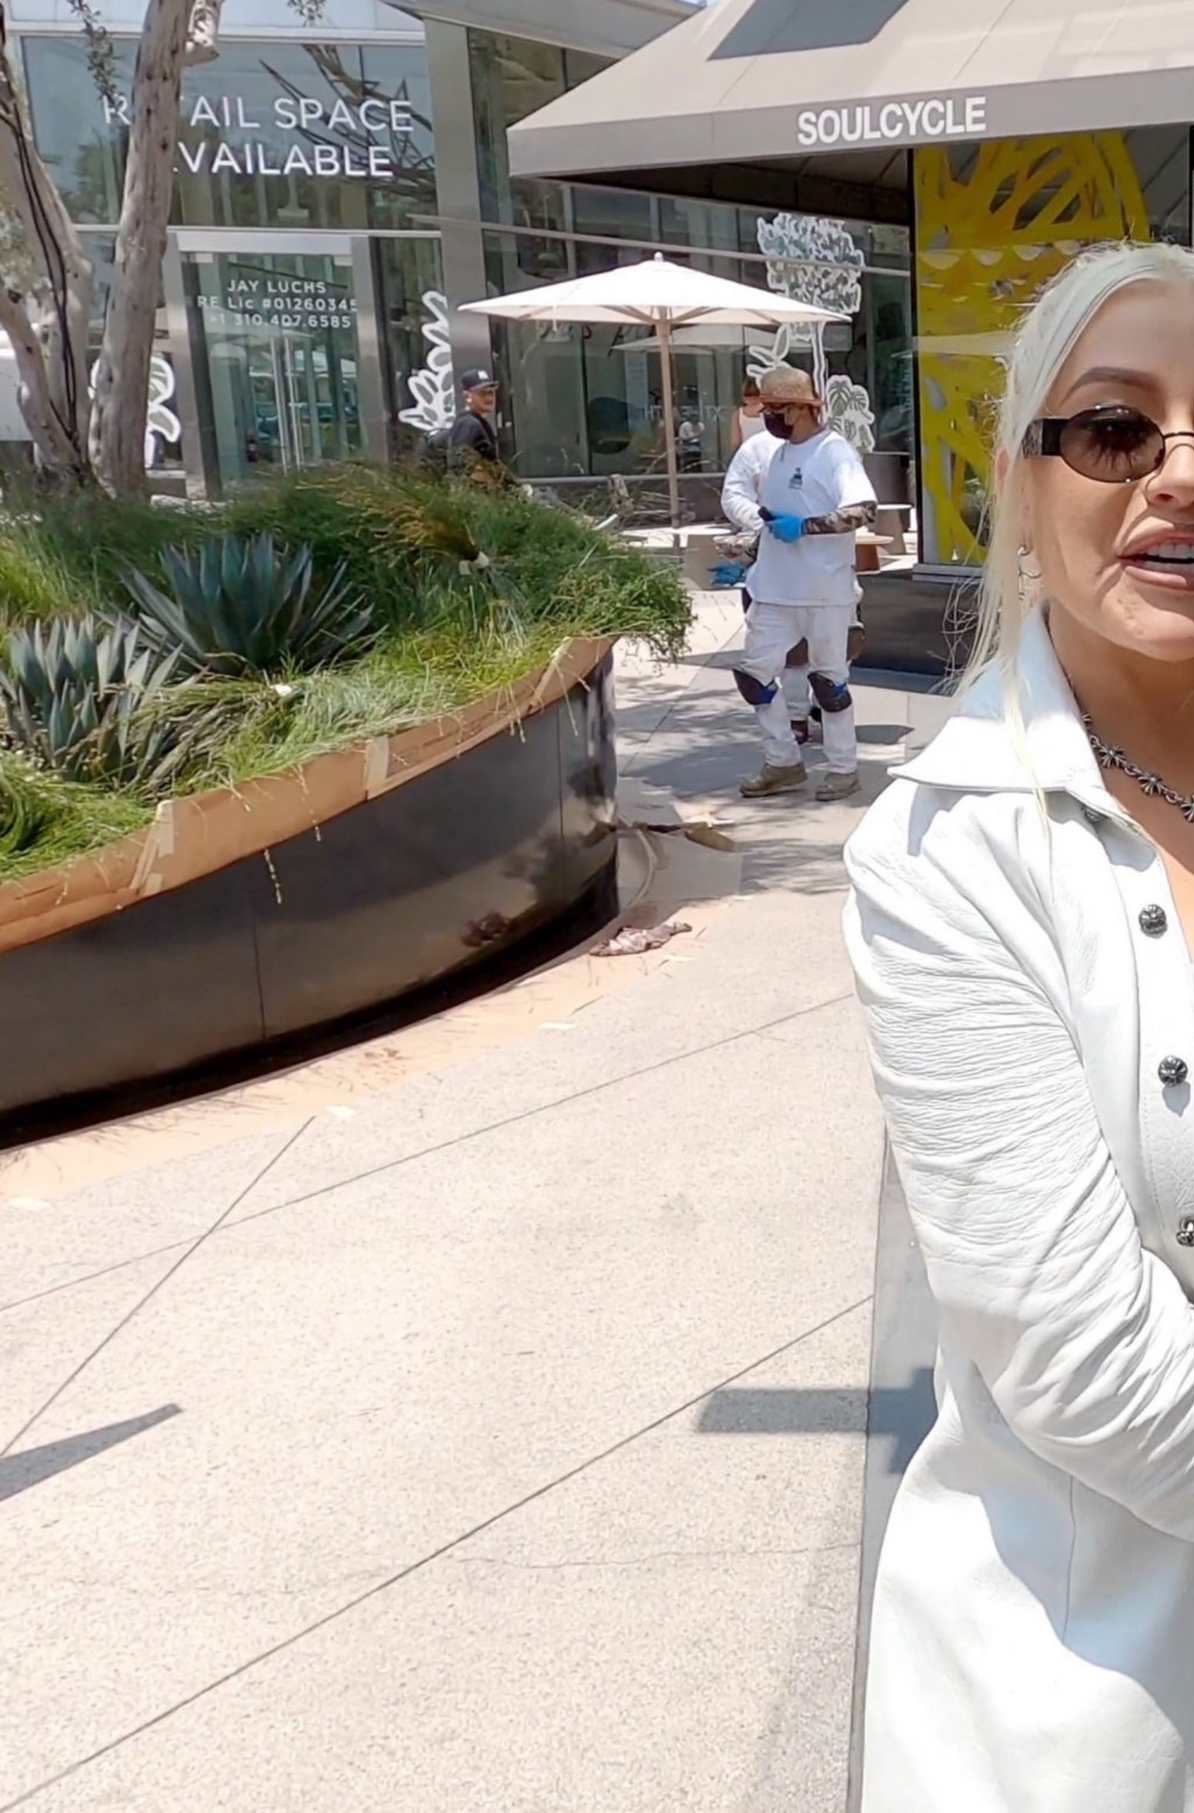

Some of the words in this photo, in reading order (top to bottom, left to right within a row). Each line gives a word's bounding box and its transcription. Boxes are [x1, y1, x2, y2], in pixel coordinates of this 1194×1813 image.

[102, 95, 260, 129] RAIL
[274, 97, 415, 131] SPACE
[798, 96, 987, 146] SOULCYCLE
[173, 141, 394, 177] VAILABLE
[227, 280, 260, 293] JAY
[267, 281, 327, 294] LUCHS
